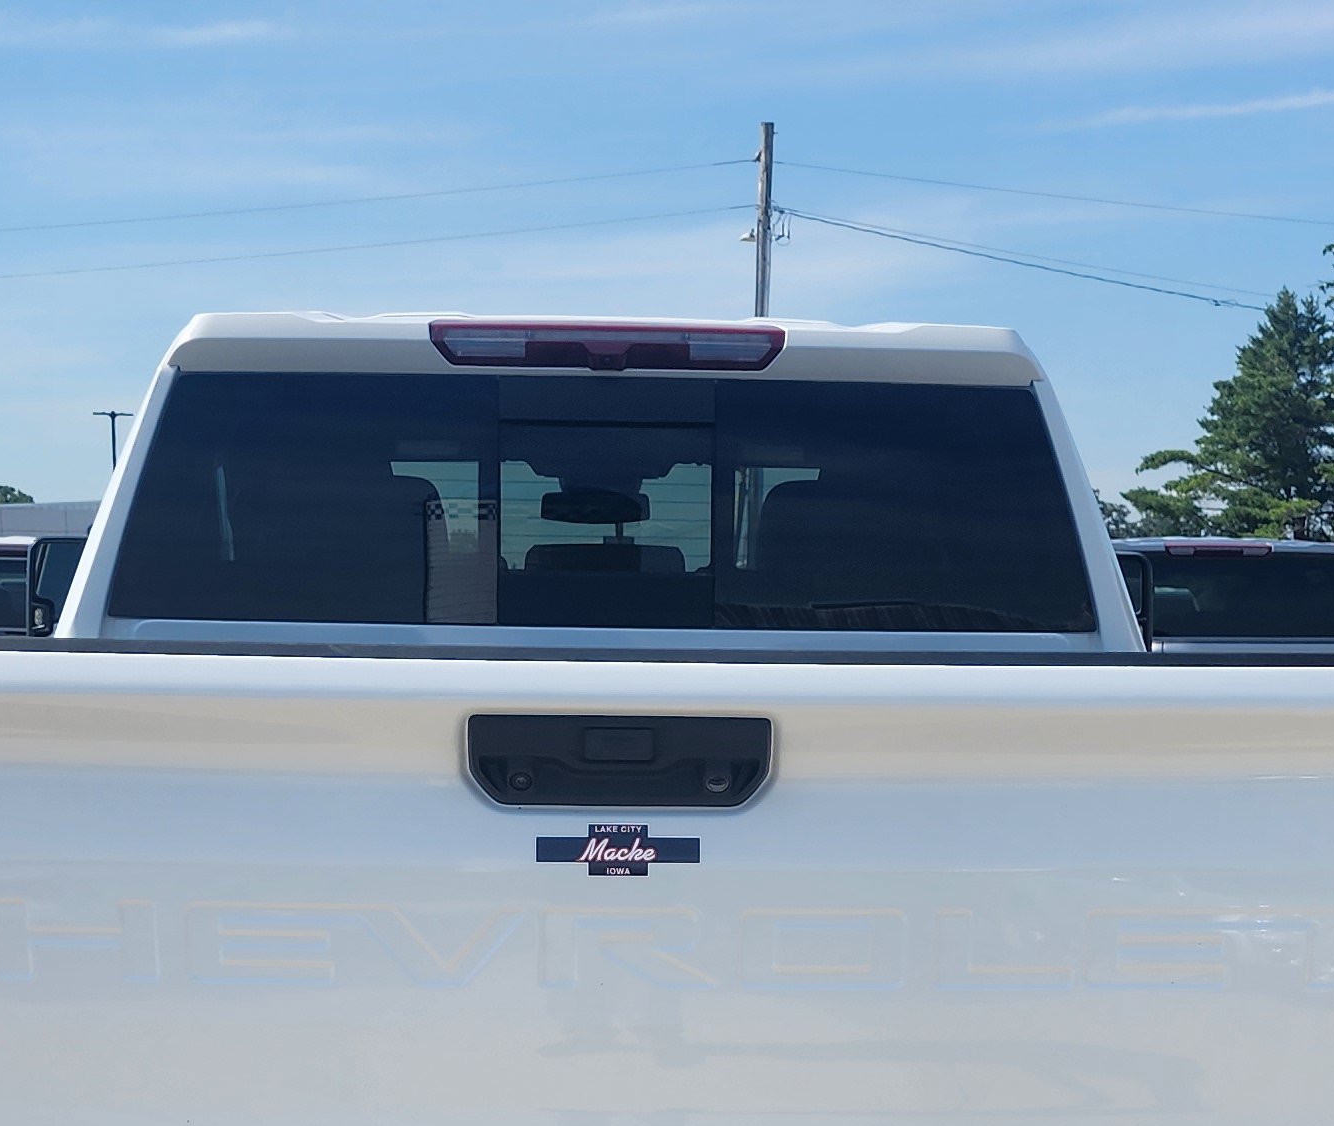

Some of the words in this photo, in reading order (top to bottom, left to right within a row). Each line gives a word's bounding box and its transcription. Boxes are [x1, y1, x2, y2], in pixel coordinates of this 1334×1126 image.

[594, 825, 618, 834] LAKE
[620, 825, 642, 834] CITY
[578, 836, 657, 863] Macke
[605, 866, 631, 876] IOWA
